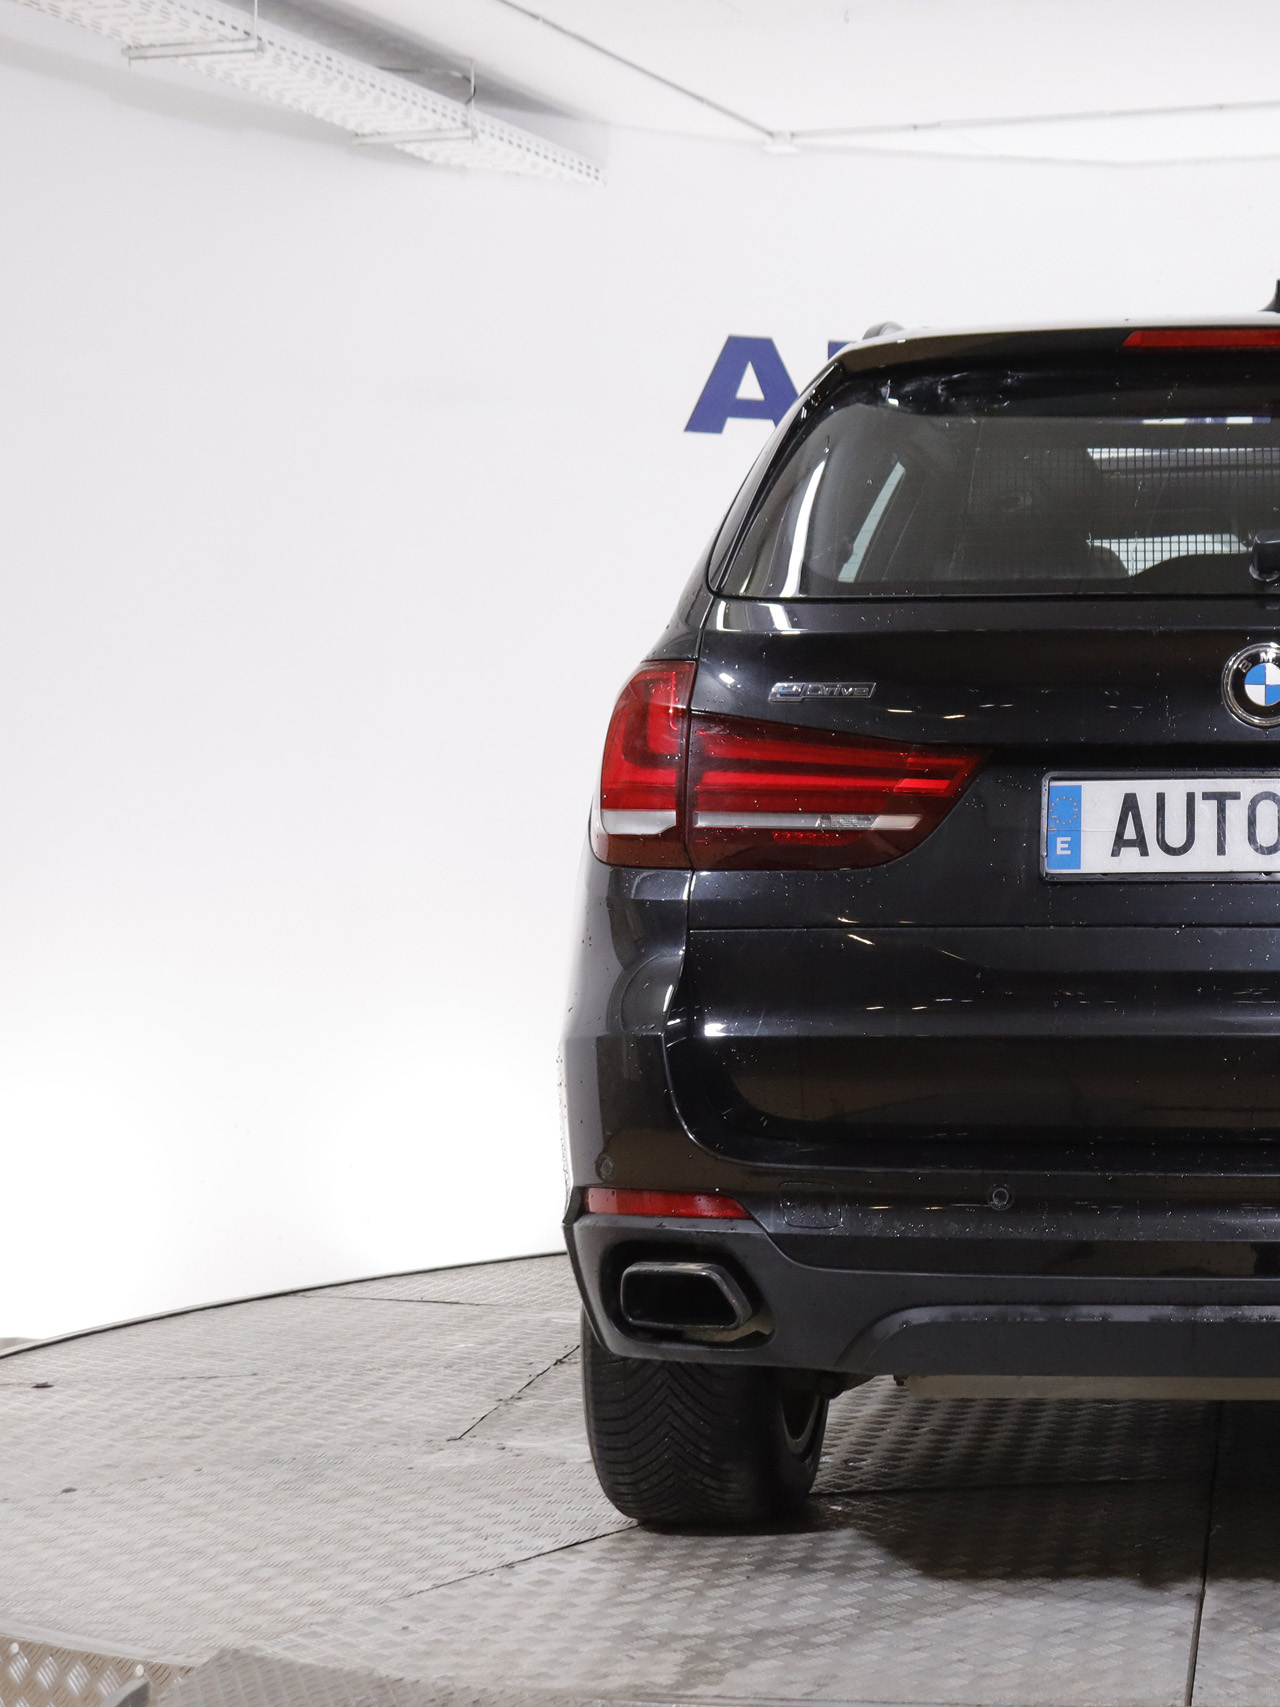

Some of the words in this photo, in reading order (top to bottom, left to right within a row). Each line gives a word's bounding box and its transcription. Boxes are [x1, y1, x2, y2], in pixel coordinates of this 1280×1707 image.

[684, 334, 857, 434] A
[769, 682, 871, 703] eDrive
[1056, 837, 1071, 855] E
